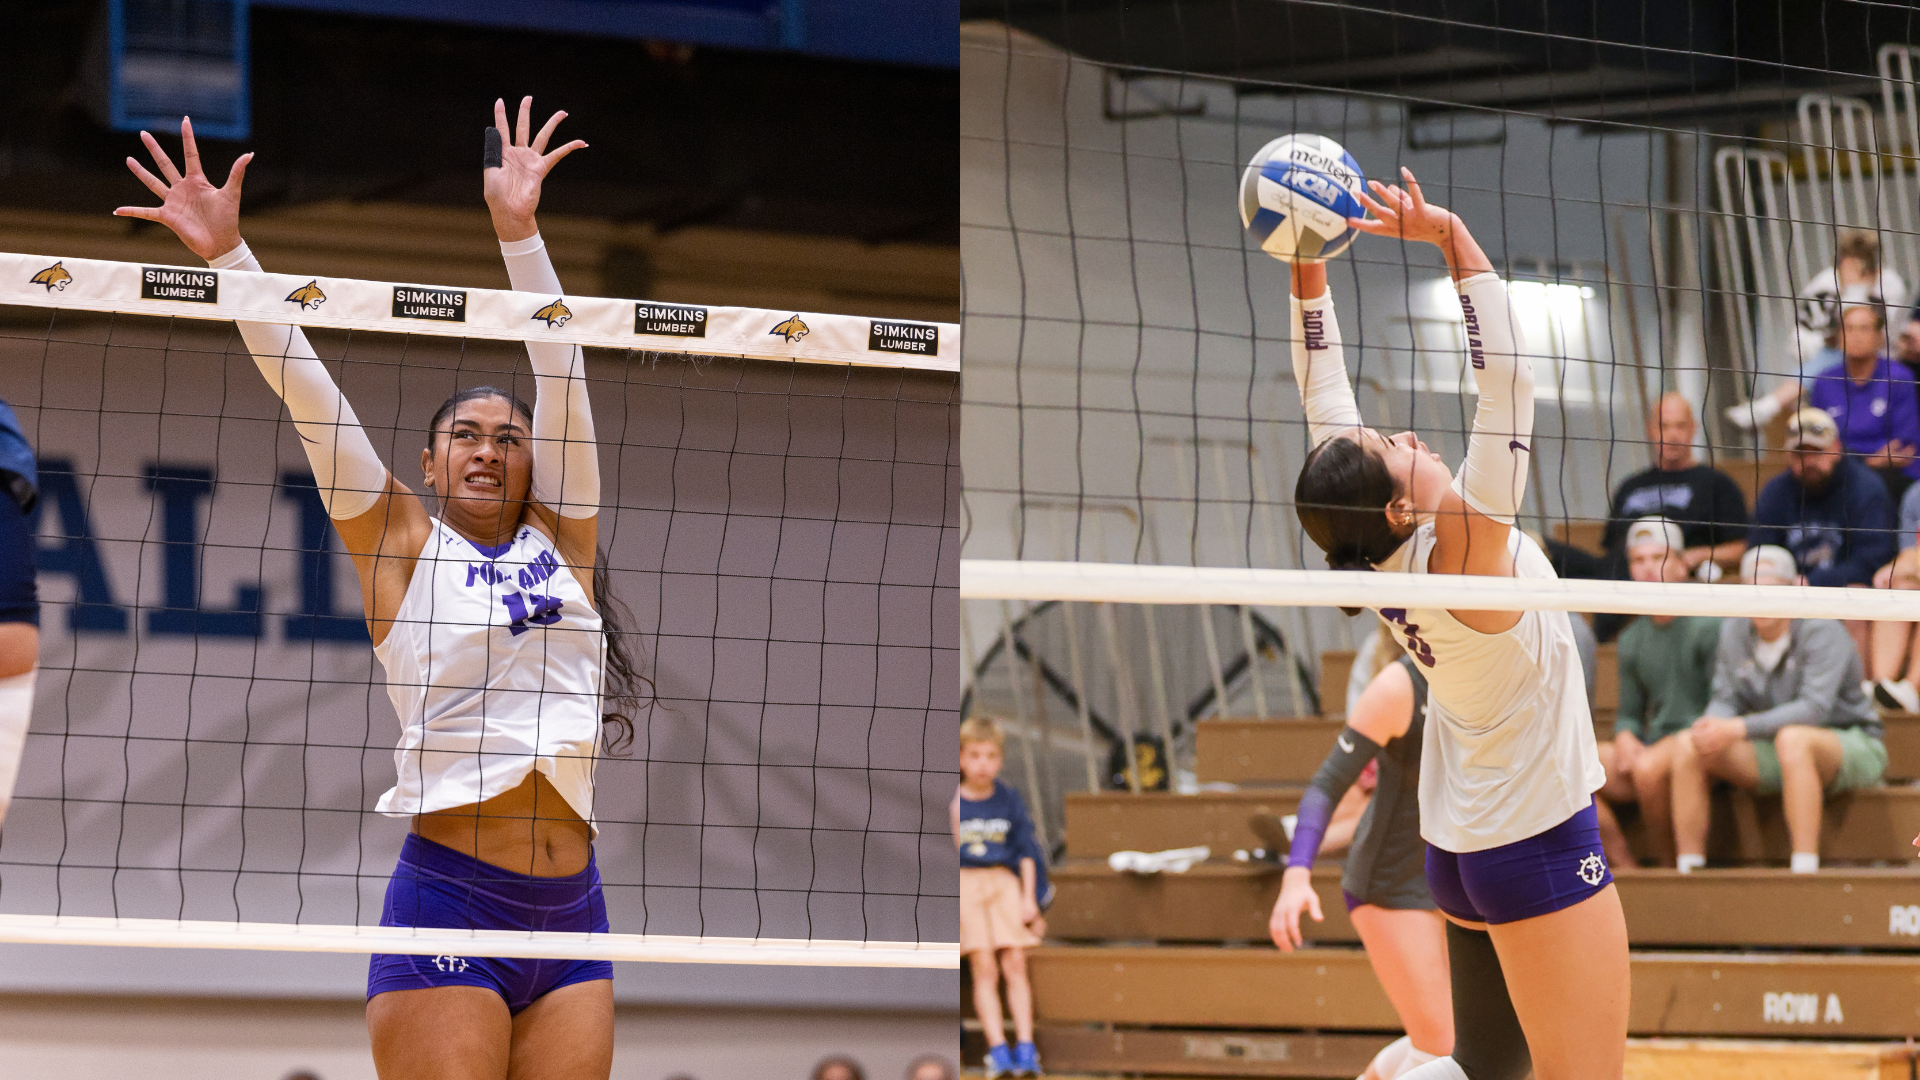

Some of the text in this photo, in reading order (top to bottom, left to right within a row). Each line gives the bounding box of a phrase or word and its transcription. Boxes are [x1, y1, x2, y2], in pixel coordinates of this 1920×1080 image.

[1290, 149, 1353, 191] molten
[145, 270, 215, 287] SIMKINS
[153, 286, 205, 299] LUMBER
[396, 290, 464, 306] SIMKINS
[403, 305, 455, 318] LUMBER
[638, 307, 705, 322] SIMKINS
[646, 321, 695, 334] LUMBER
[873, 324, 936, 341] SIMKINS
[1303, 309, 1329, 351] PILOTS
[1459, 294, 1486, 370] PORTLAND
[880, 338, 926, 352] LUMBER
[465, 549, 560, 591] POAND
[1763, 991, 1845, 1023] ROW A
